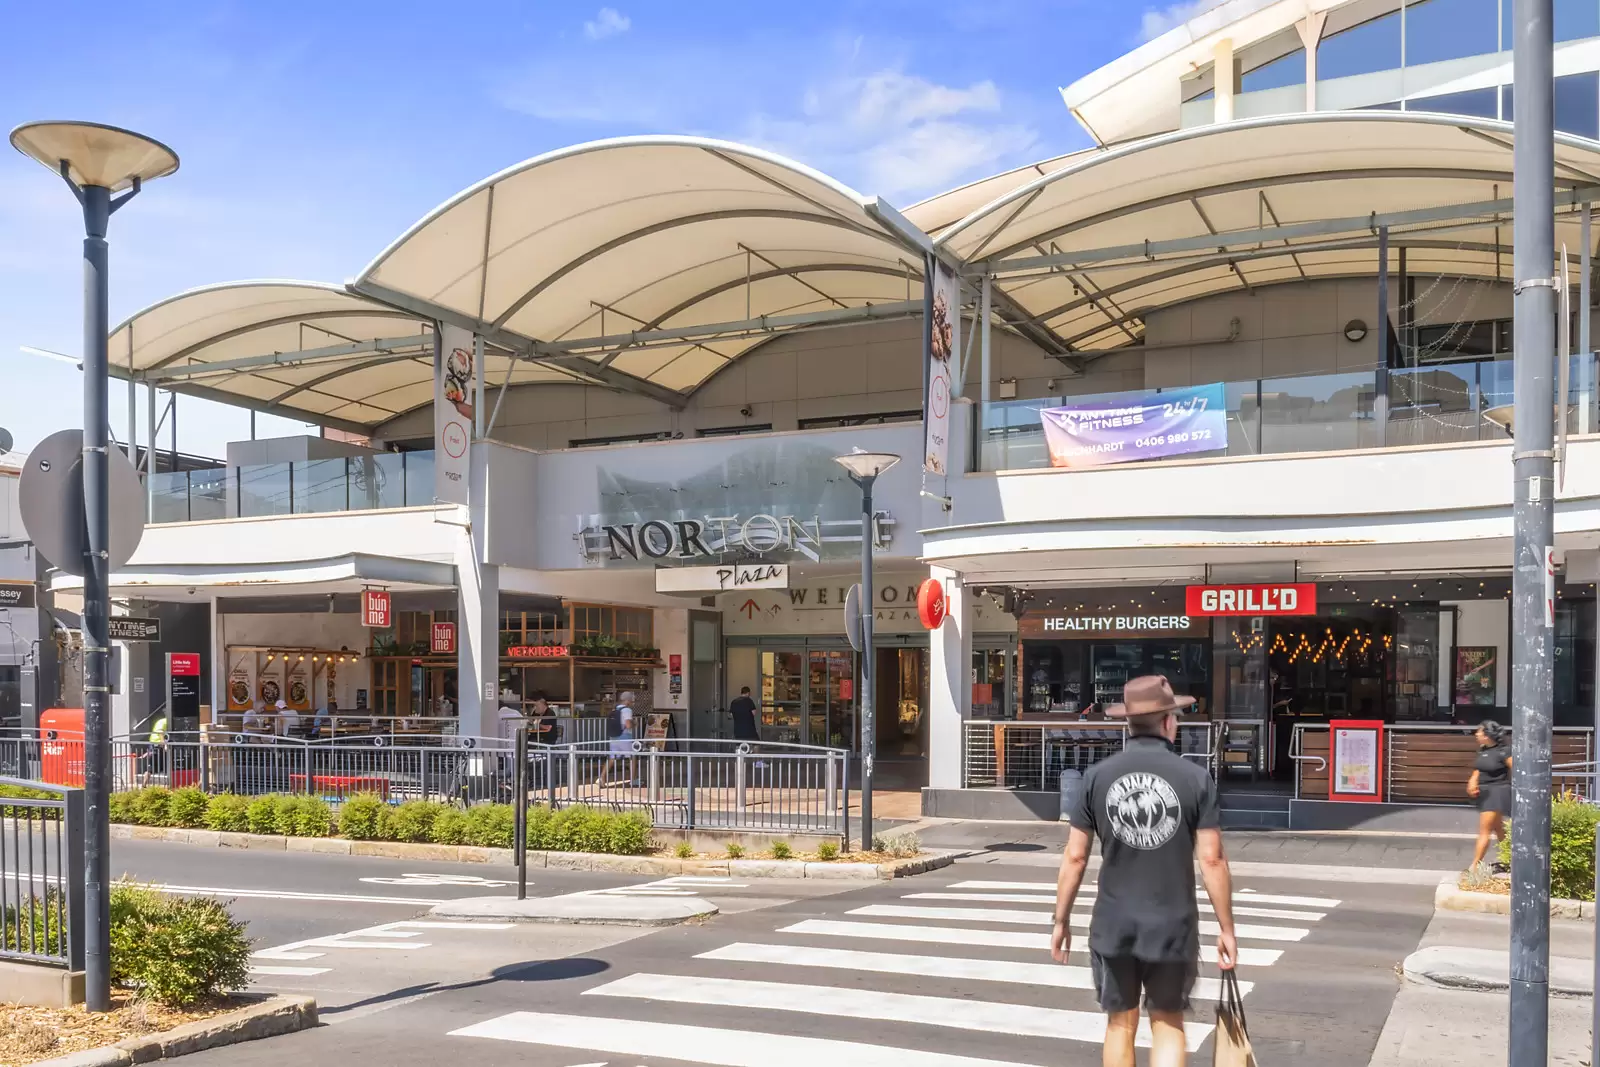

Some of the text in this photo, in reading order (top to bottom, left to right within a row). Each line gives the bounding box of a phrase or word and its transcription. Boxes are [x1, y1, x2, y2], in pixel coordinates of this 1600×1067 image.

[1079, 406, 1143, 421] ANYTIME
[1079, 414, 1144, 432] FITNESS
[1057, 429, 1212, 457] LCHHARDT 0406 980 572
[602, 513, 820, 561] NORTON
[716, 564, 783, 590] Plaza
[368, 593, 387, 612] bún
[1202, 588, 1298, 611] GRILL'D
[369, 611, 385, 625] me
[1044, 615, 1190, 630] HEALTHY BURGERS
[109, 621, 146, 631] NYTIME
[109, 629, 146, 637] ITNESS
[434, 625, 452, 640] bún
[435, 640, 449, 651] me
[508, 646, 568, 657] VIET KITCHEN
